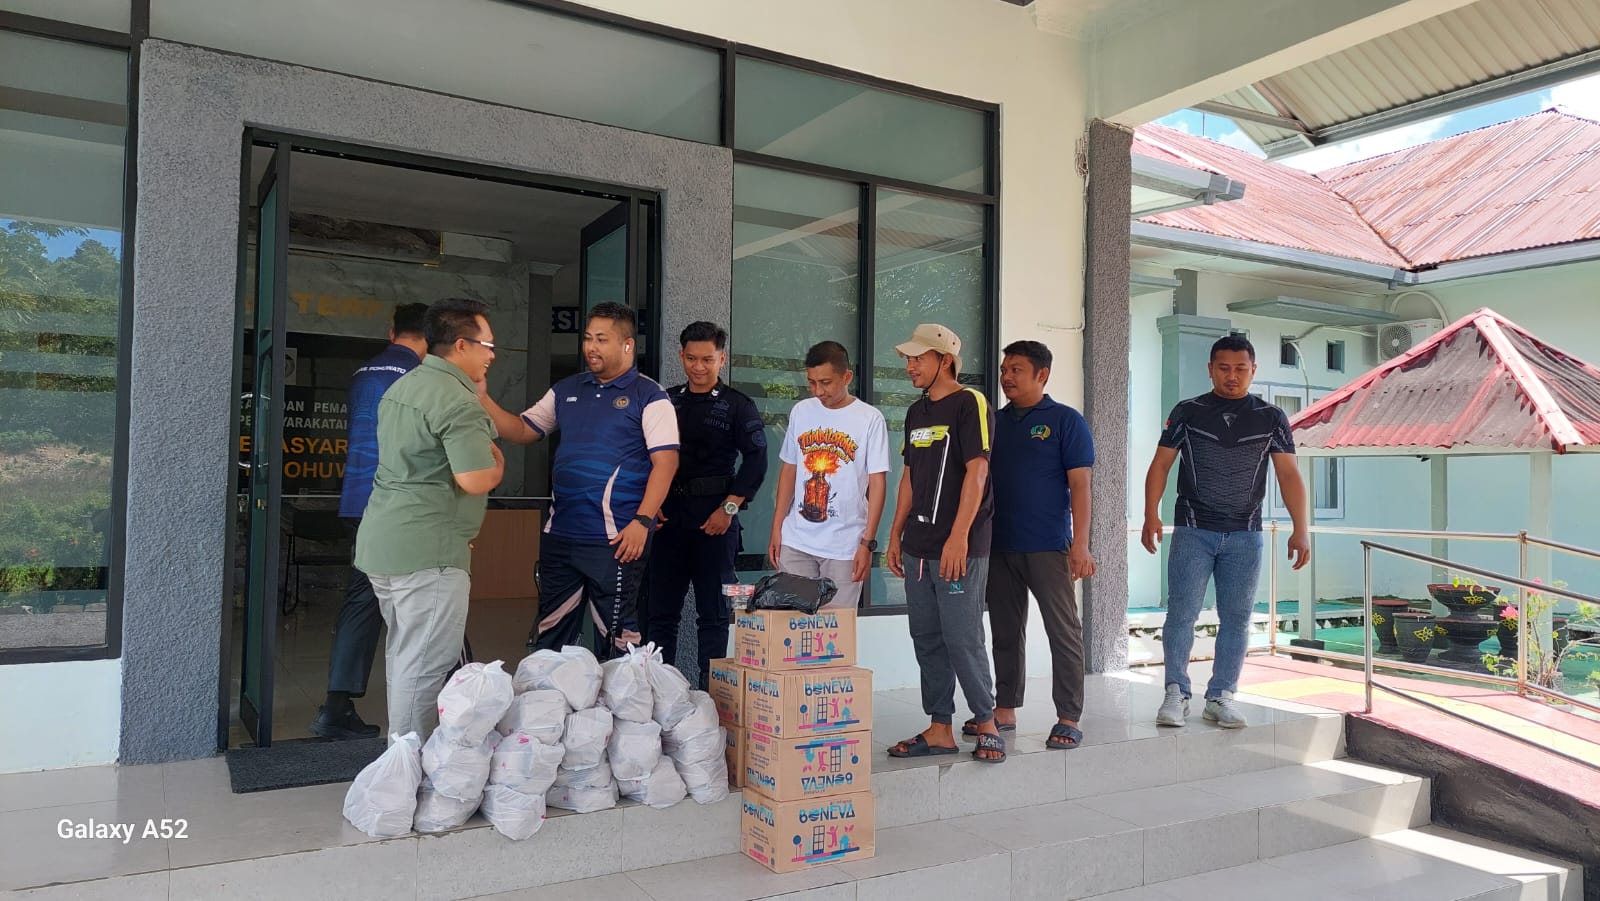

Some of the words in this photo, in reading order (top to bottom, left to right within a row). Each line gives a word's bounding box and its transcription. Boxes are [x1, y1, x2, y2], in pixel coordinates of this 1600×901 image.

[789, 614, 839, 631] BONEVA
[804, 679, 854, 697] BONEVA
[799, 803, 856, 824] BONEVA
